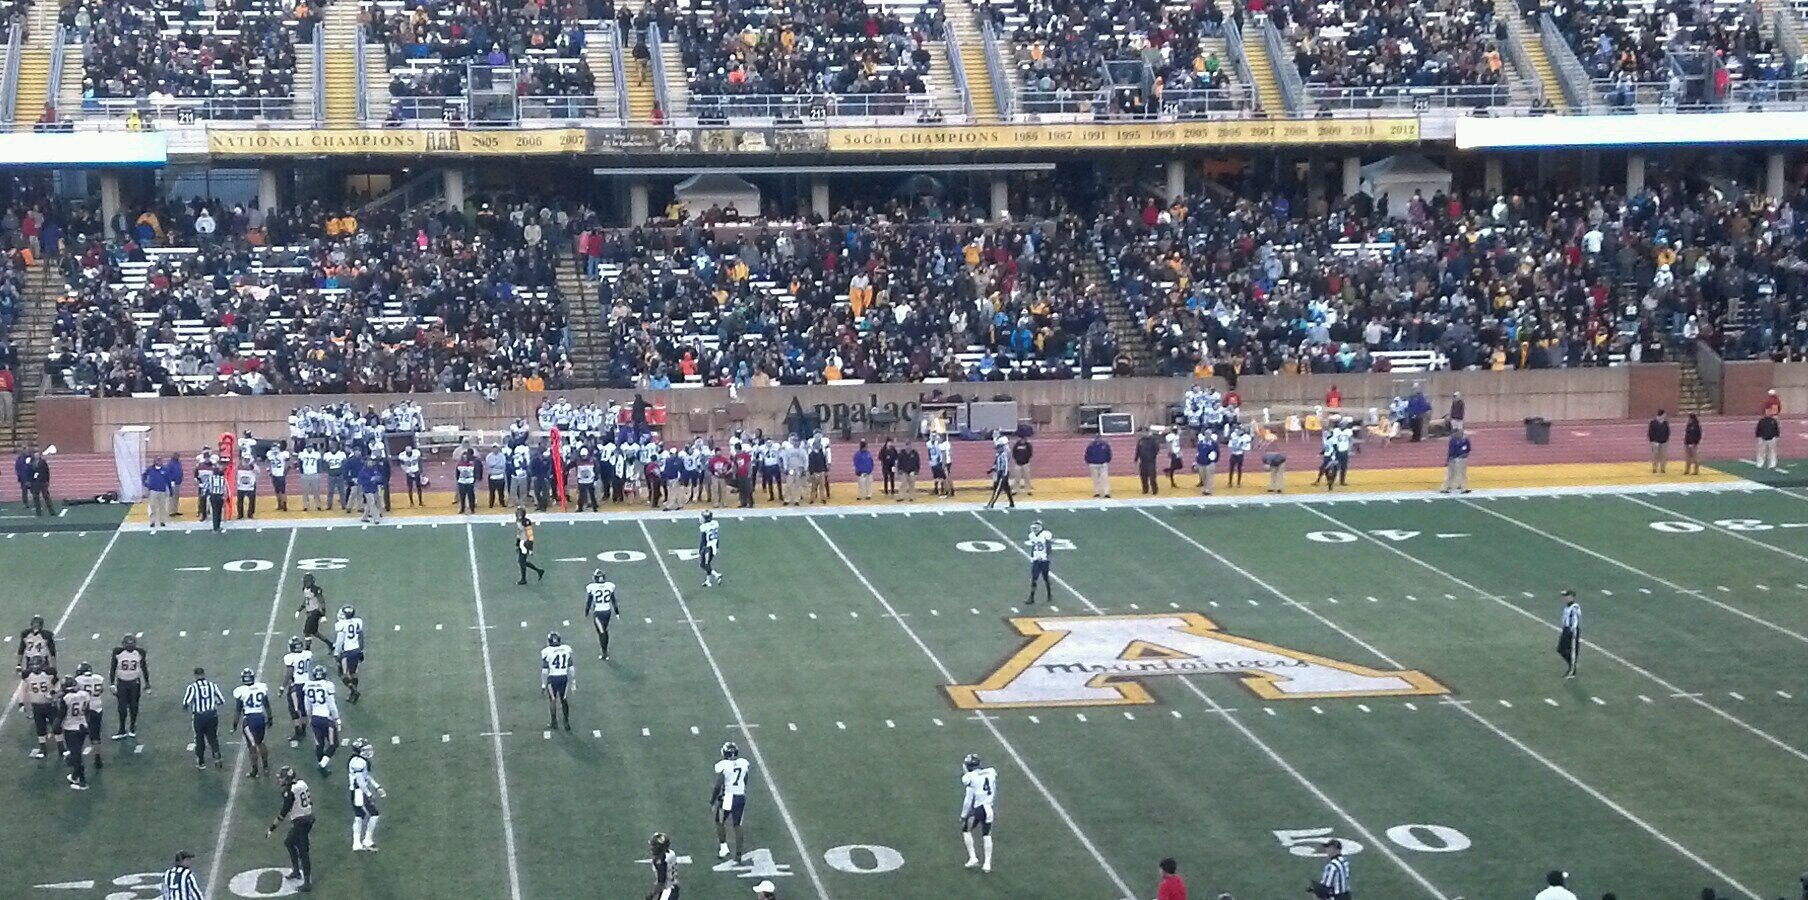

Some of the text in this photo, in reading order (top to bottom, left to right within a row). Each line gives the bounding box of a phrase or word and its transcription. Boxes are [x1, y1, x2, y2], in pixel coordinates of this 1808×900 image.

[178, 112, 194, 124] 211
[212, 134, 415, 148] NATIONAL CHAMPIONS
[559, 135, 585, 146] 2007
[843, 133, 892, 145] SoCon
[900, 131, 999, 144] CHAMPIONS
[1049, 131, 1072, 141] 1987
[1082, 130, 1106, 140] 1991
[1117, 130, 1141, 140] 1995
[1251, 127, 1275, 137] 2007
[1390, 125, 1415, 135] 2012
[594, 589, 611, 604] 22
[121, 659, 137, 671] 63
[552, 653, 567, 669] 41
[245, 692, 265, 708] 49
[307, 688, 326, 705] 93
[732, 767, 742, 786] 7
[982, 777, 993, 796] 4
